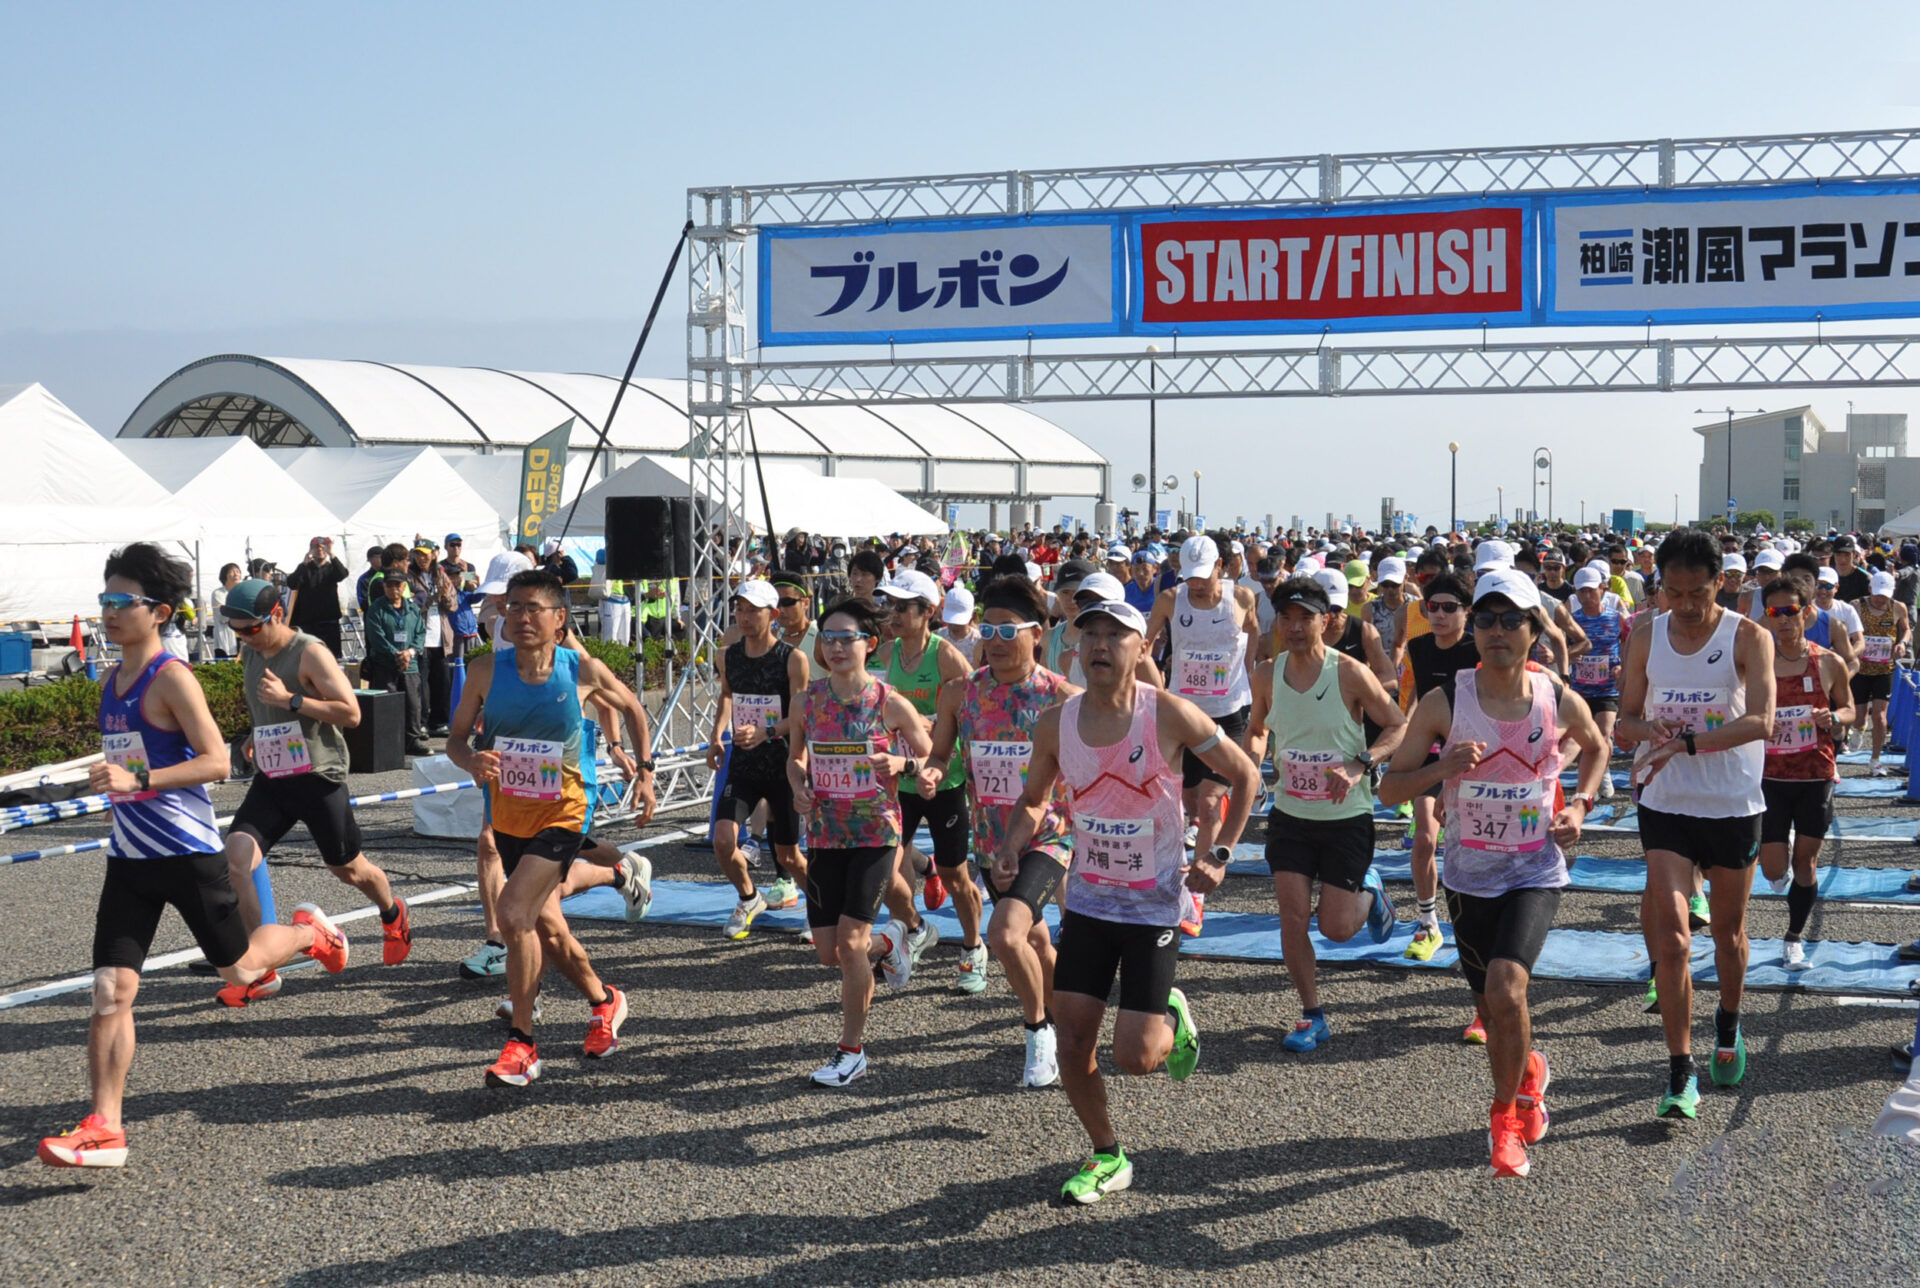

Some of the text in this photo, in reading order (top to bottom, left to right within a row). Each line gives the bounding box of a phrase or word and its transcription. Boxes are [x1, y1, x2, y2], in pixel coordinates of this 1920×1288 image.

[1155, 227, 1507, 306] START/FINISH
[810, 249, 1070, 317] ブルボン
[523, 448, 551, 537] DEPO
[545, 463, 562, 518] SPORT
[1186, 651, 1224, 662] ブルボン
[1186, 674, 1207, 687] 488
[737, 695, 774, 705] ブルボン
[1662, 689, 1717, 703] ブルボン
[257, 725, 292, 739] ブルボン
[502, 739, 554, 754] ブルボン
[834, 745, 865, 754] DEPO
[979, 743, 1032, 756] ブルボン
[1287, 751, 1334, 762] ブルボン
[500, 769, 537, 787] 1094
[815, 772, 851, 788] 2014
[981, 776, 1009, 794] 721
[1291, 775, 1318, 791] 828
[1469, 783, 1533, 800] ブルボン
[1082, 818, 1142, 836] ブルボン
[1472, 819, 1508, 839] 347
[1086, 847, 1144, 872] 片桐 一洋
